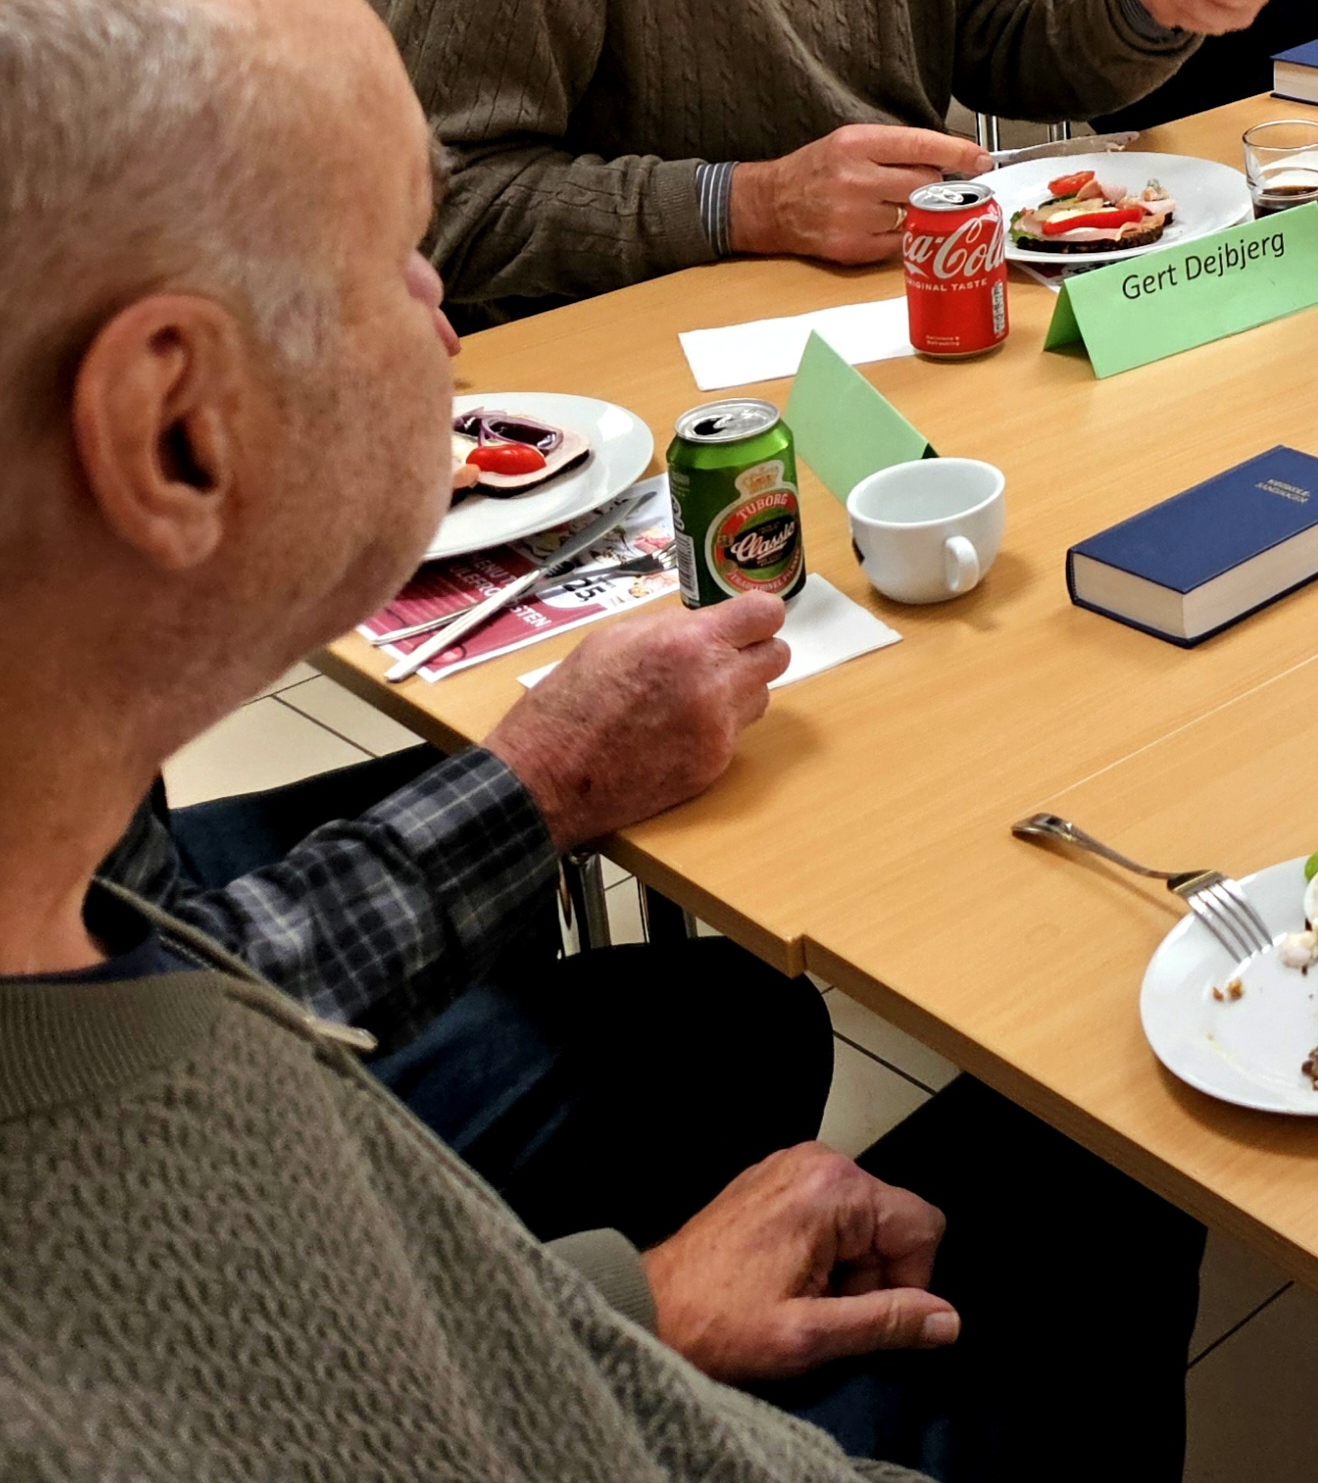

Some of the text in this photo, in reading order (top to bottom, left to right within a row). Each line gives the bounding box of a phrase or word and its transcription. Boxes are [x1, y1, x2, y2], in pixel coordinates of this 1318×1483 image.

[1122, 232, 1285, 300] Gert Dejbjerg
[951, 277, 988, 292] TASTE
[736, 492, 789, 521] TUBORG
[730, 520, 796, 563] Classic
